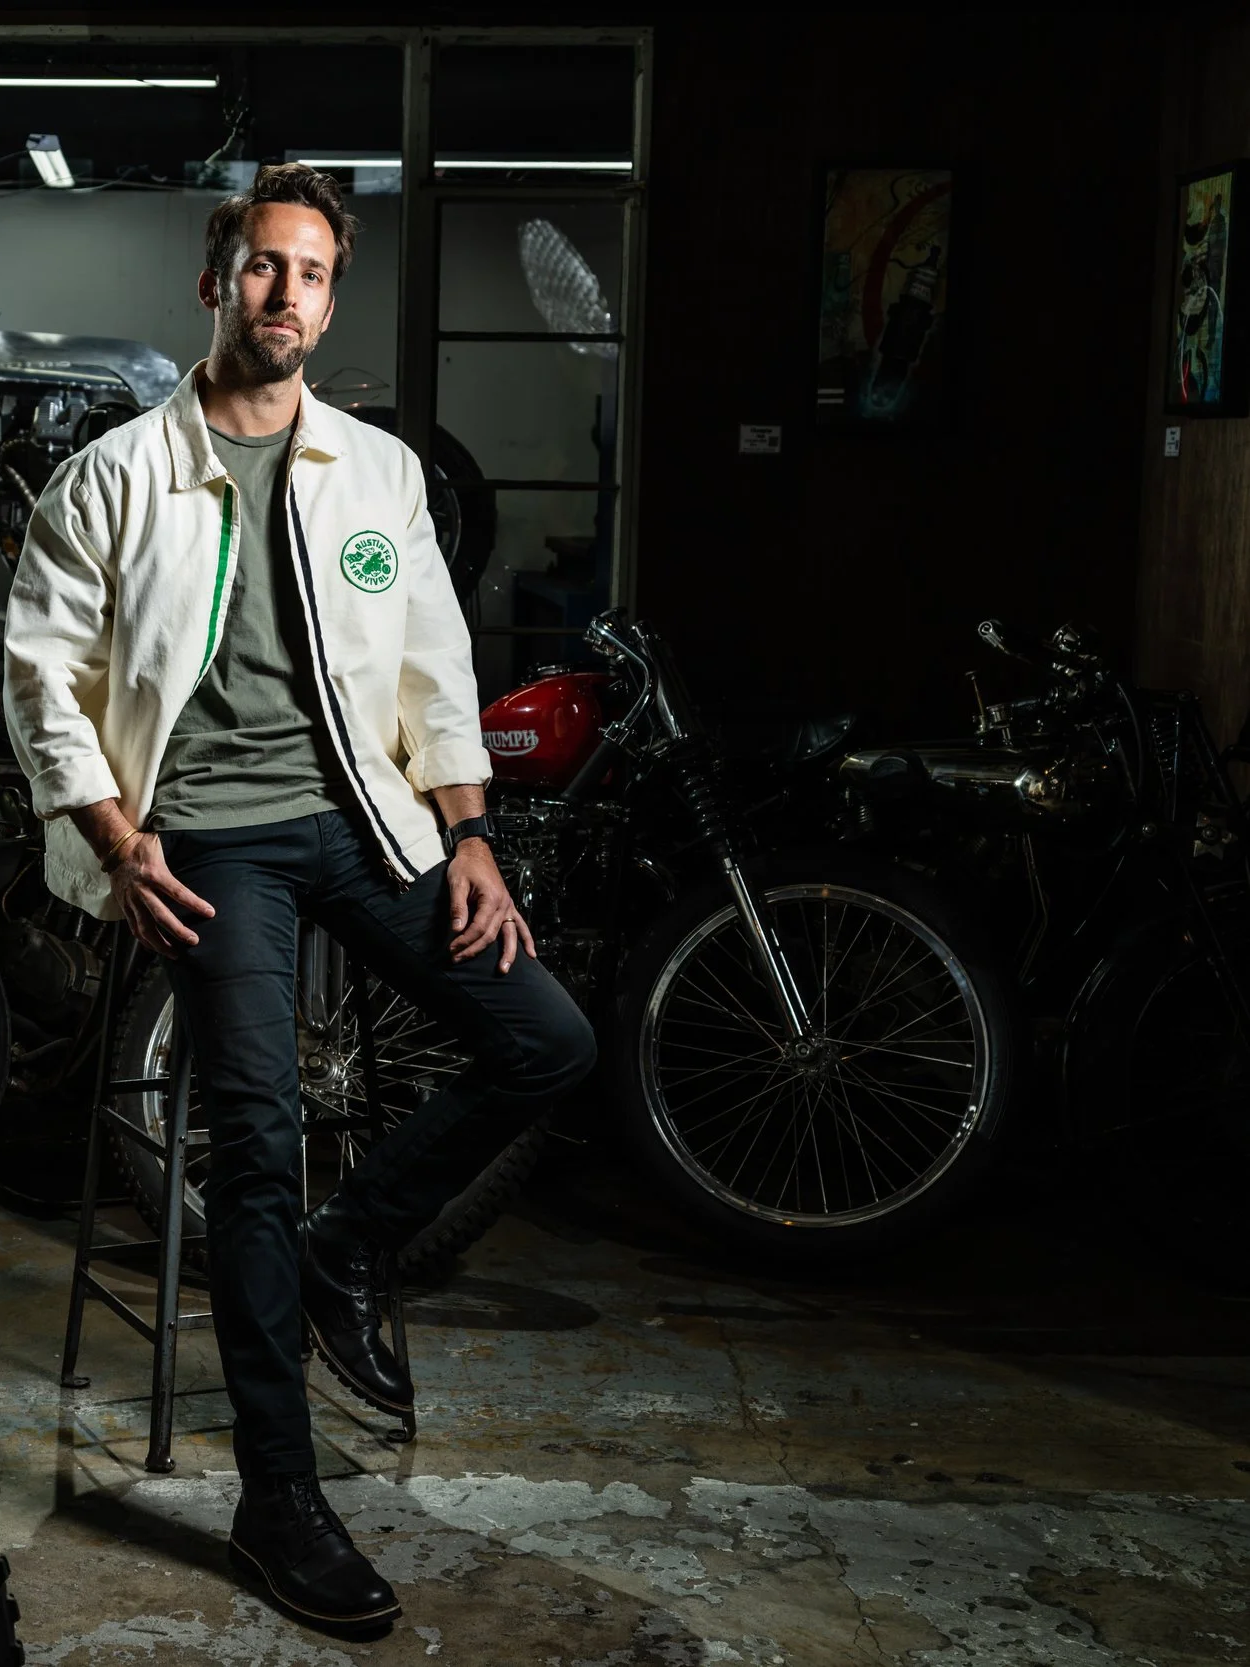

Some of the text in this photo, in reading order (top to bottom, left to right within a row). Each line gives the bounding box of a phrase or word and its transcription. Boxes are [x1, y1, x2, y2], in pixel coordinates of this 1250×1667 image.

[355, 539, 391, 561] AUSTIN FC
[352, 569, 388, 585] REVIVAL
[481, 729, 538, 748] RIUMPH
